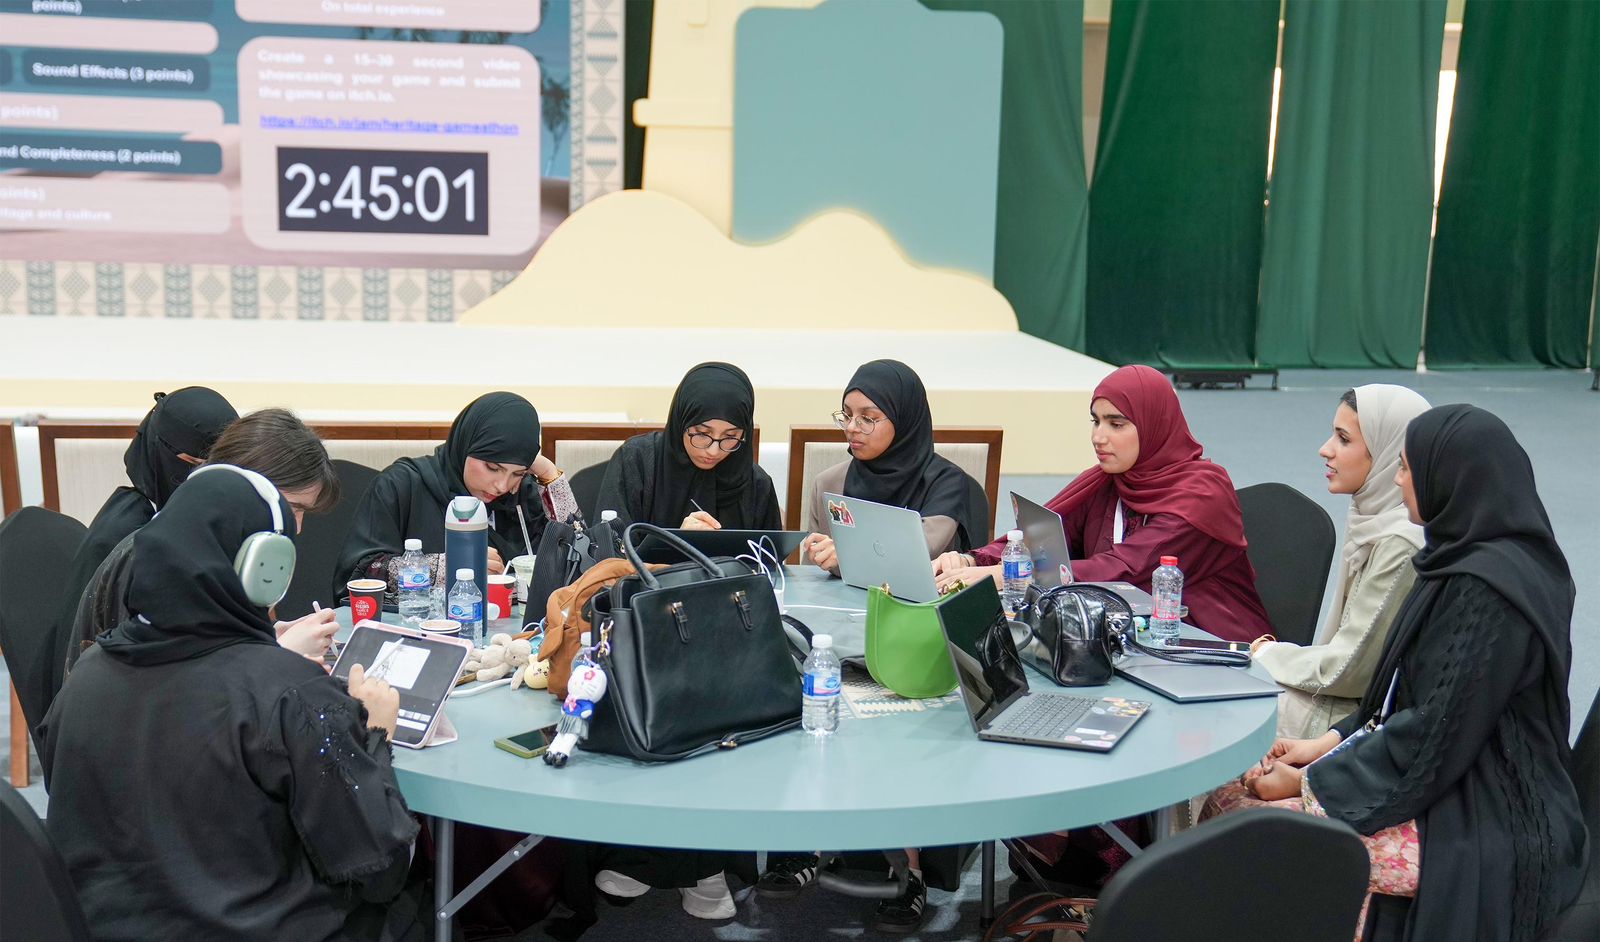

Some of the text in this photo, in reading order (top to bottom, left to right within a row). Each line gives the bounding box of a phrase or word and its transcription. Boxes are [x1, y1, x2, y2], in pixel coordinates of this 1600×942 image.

[32, 0, 83, 16] points)
[321, 0, 446, 17] On total experience
[257, 48, 305, 64] Create
[323, 54, 334, 65] a
[412, 56, 464, 70] second
[482, 57, 521, 71] video
[32, 61, 194, 84] Sound Effects (3 points)
[258, 69, 521, 89] showcasing your game and submit
[258, 86, 395, 103] the game on itch.io.
[0, 144, 182, 166] nd Completeness (2 points)
[0, 186, 46, 203] oints)
[284, 163, 476, 223] 2:45:01
[37, 208, 63, 220] and
[64, 209, 113, 221] culture
